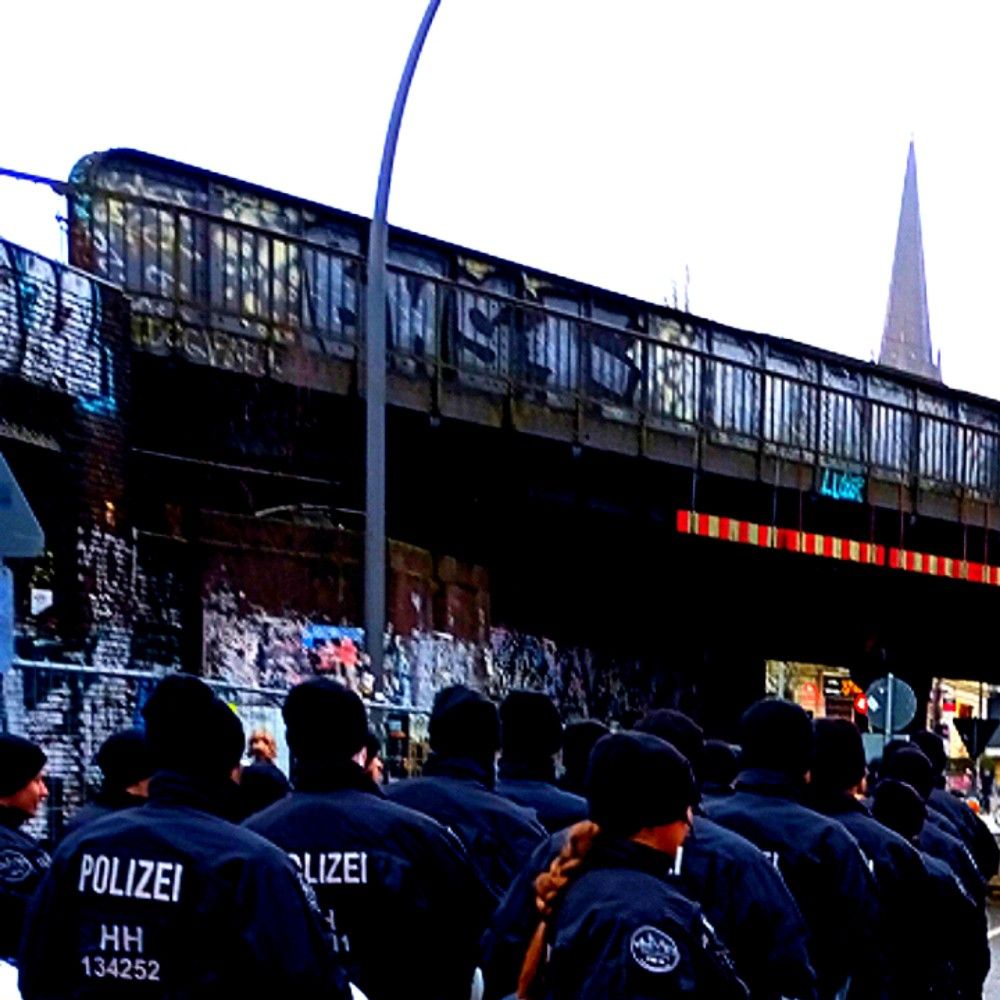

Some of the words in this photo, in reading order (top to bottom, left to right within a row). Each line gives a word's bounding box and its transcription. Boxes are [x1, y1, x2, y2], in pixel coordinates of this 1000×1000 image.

[79, 853, 183, 902] POLIZEI
[100, 924, 144, 952] HH
[81, 955, 160, 981] 134252
